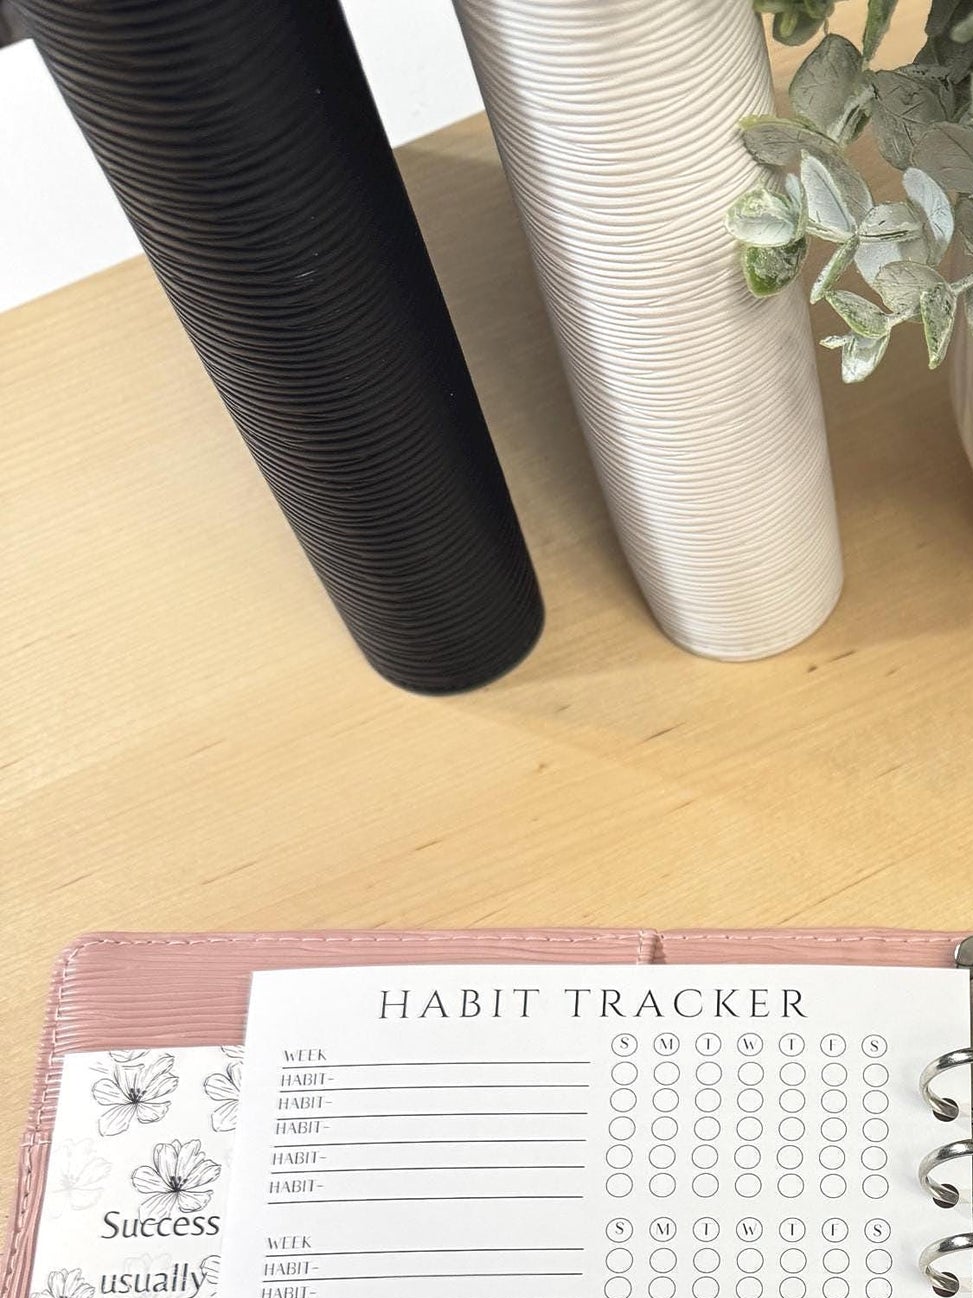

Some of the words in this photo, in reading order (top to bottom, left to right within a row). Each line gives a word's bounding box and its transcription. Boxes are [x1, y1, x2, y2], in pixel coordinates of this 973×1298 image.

[378, 988, 541, 1020] HABIT
[563, 988, 808, 1019] TRACKER
[283, 1048, 327, 1063] WEEK
[101, 1211, 220, 1239] Success
[267, 1235, 312, 1250] WEEK
